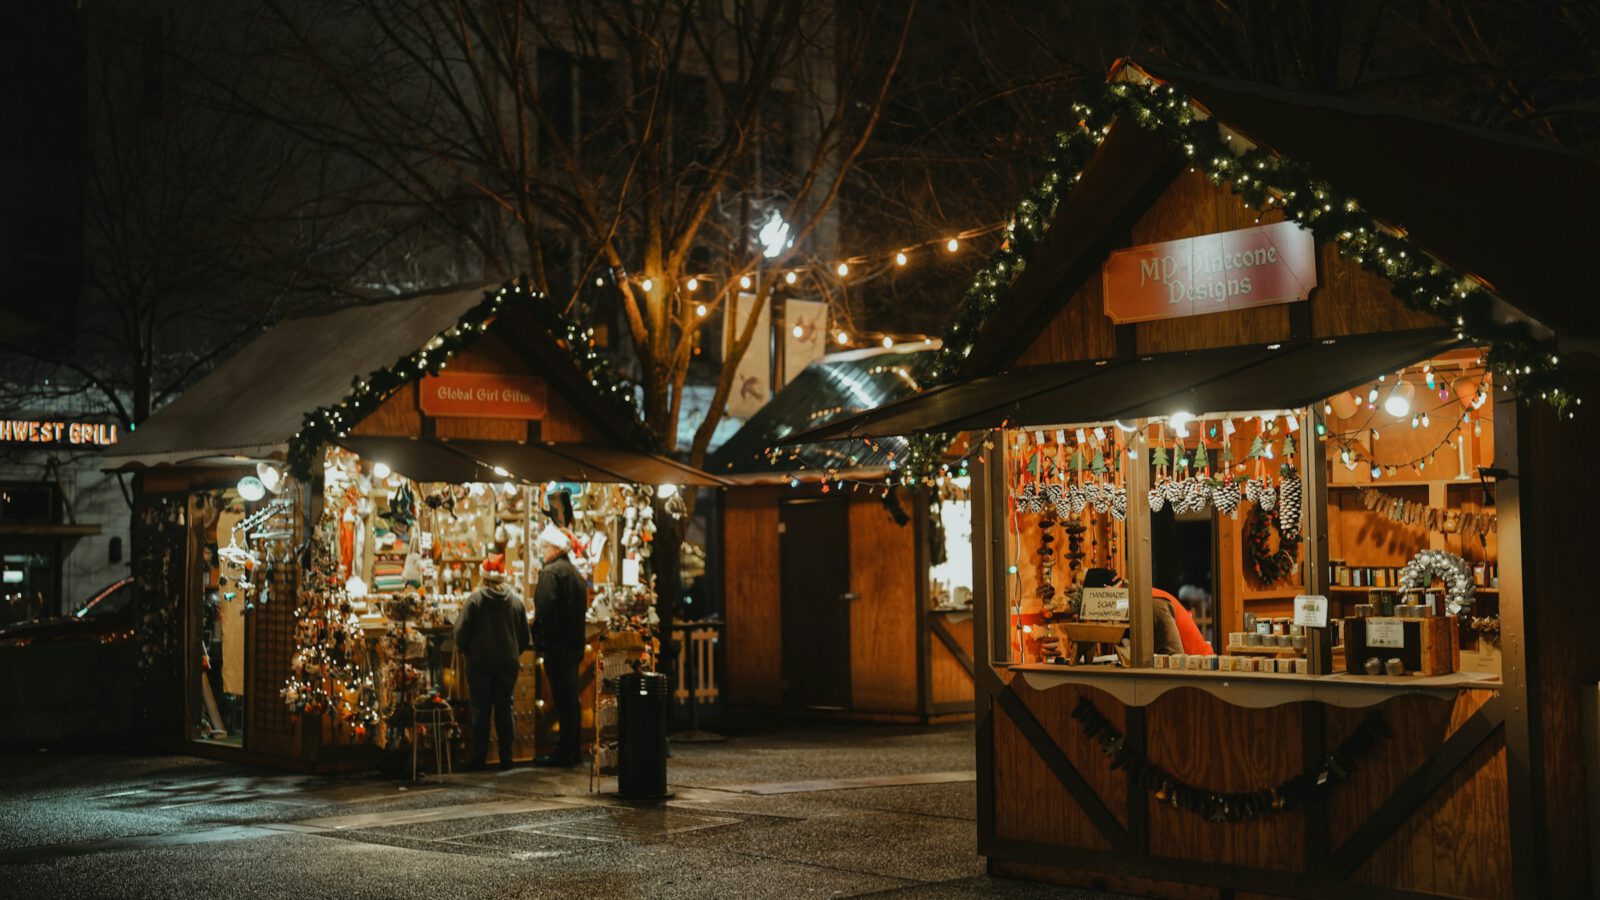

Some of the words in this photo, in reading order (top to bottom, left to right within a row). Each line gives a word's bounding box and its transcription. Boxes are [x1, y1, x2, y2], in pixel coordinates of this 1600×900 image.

[1140, 255, 1178, 287] MP
[1184, 246, 1278, 281] Pinecone
[1167, 276, 1252, 304] Designs
[437, 386, 473, 401] Global
[477, 388, 498, 402] Girl
[502, 389, 531, 403] Gifts
[69, 422, 118, 445] GRILL
[1089, 591, 1126, 599] HANDMADE
[1097, 600, 1116, 609] SOAP
